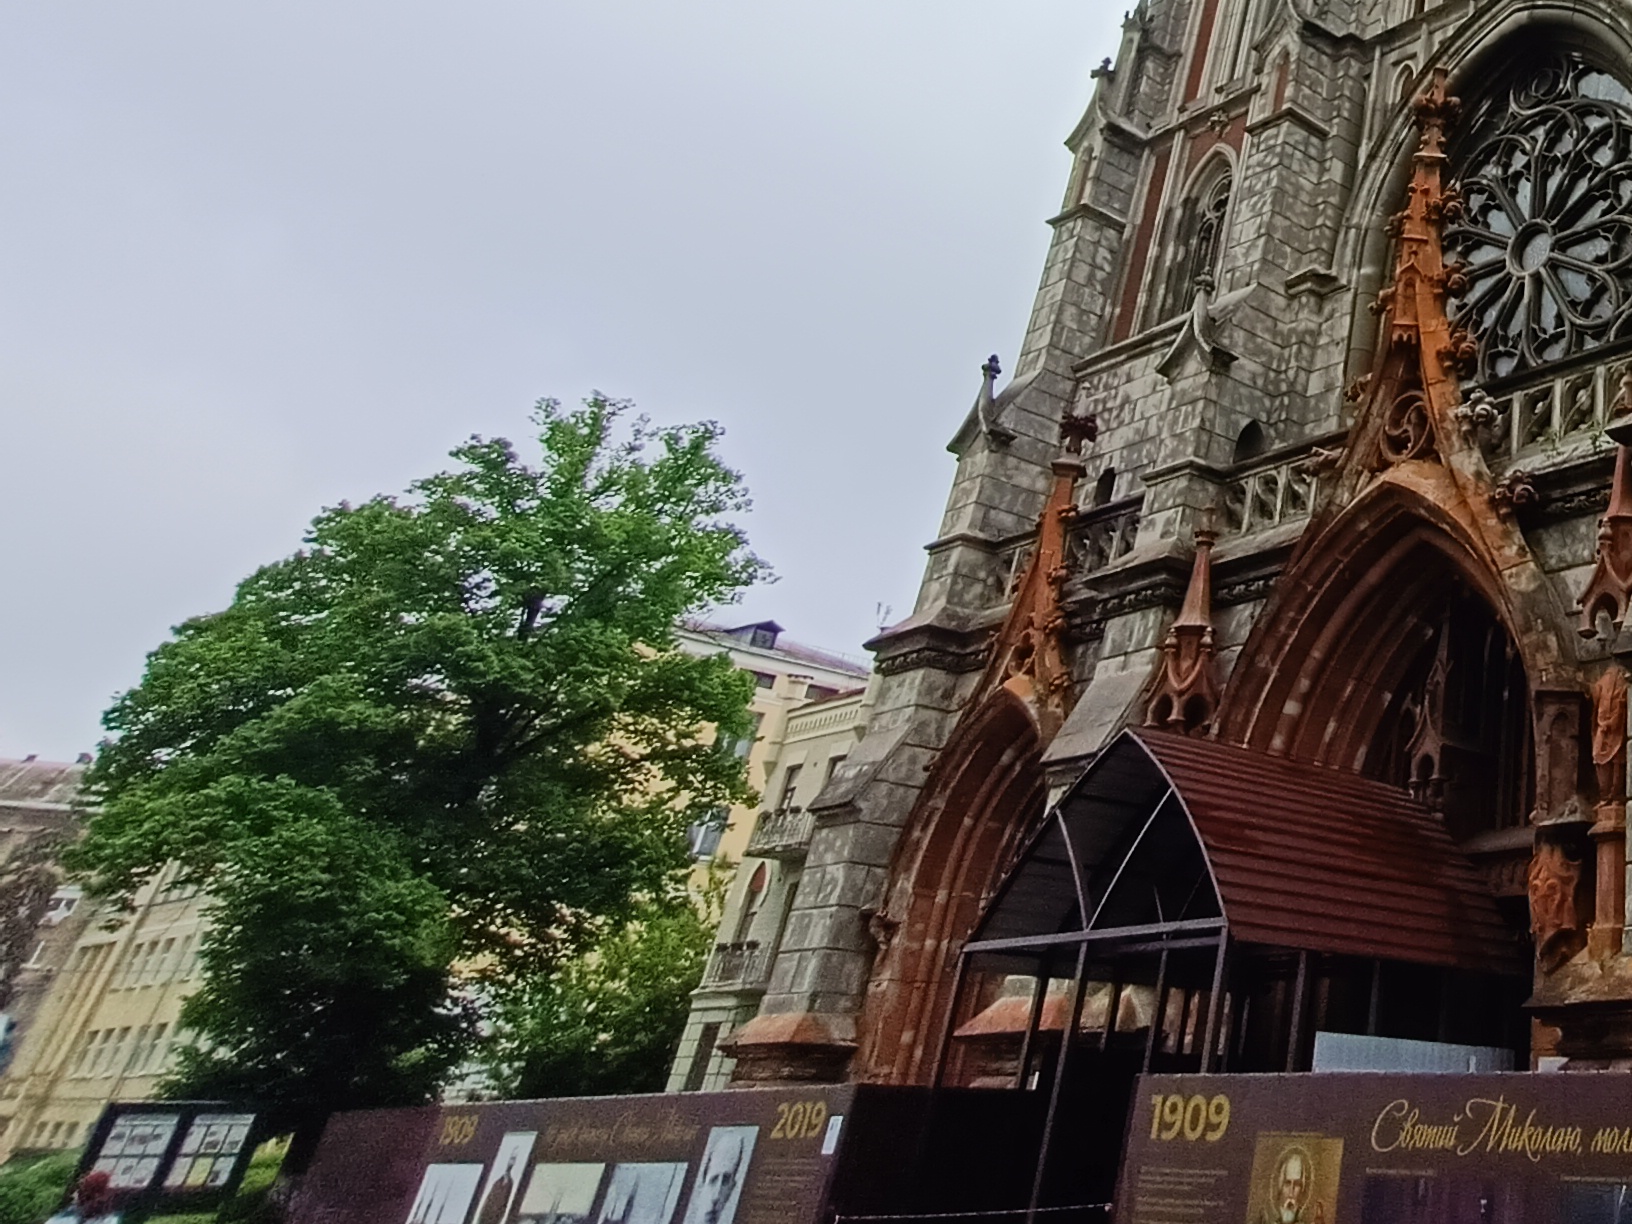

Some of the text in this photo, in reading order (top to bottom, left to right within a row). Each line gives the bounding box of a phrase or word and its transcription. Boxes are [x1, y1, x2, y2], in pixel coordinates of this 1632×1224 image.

[439, 1115, 479, 1145] 1909
[770, 1101, 827, 1139] 2019
[1150, 1094, 1230, 1141] 1909
[1371, 1099, 1462, 1152] Святий
[1457, 1095, 1582, 1162] Миколаю,
